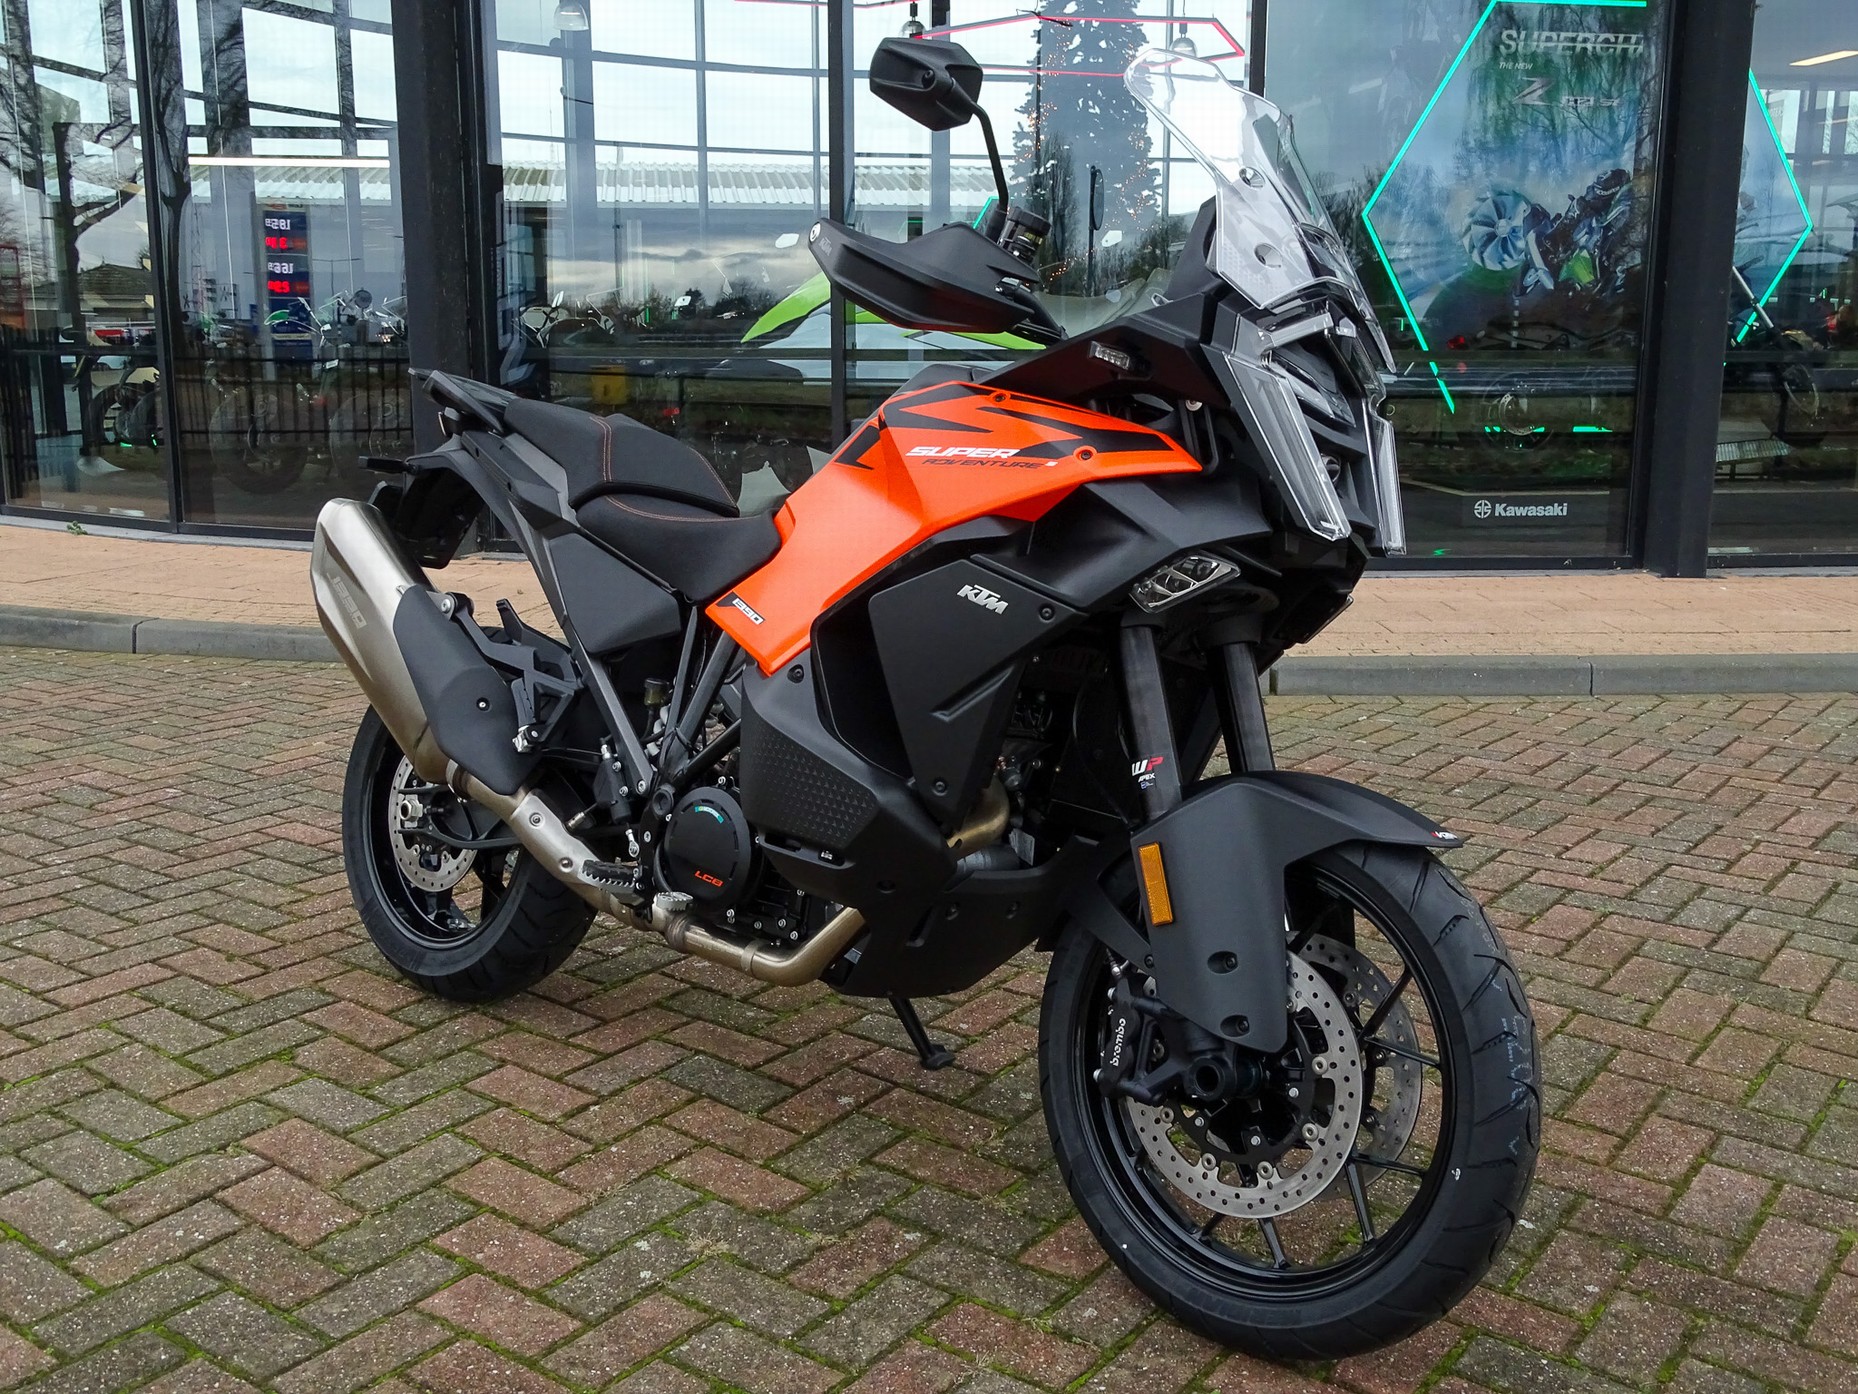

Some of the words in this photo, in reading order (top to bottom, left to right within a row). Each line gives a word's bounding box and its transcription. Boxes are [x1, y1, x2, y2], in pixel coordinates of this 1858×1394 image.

[1500, 61, 1513, 70] THE
[1515, 62, 1534, 70] NEW
[905, 446, 1021, 459] SUPER
[922, 458, 1044, 469] ADVENTURE
[1494, 503, 1568, 517] Kawasaki
[957, 584, 1009, 615] KTM
[1131, 756, 1164, 776] WP
[694, 872, 724, 887] LC8
[1110, 1018, 1126, 1067] brembo
